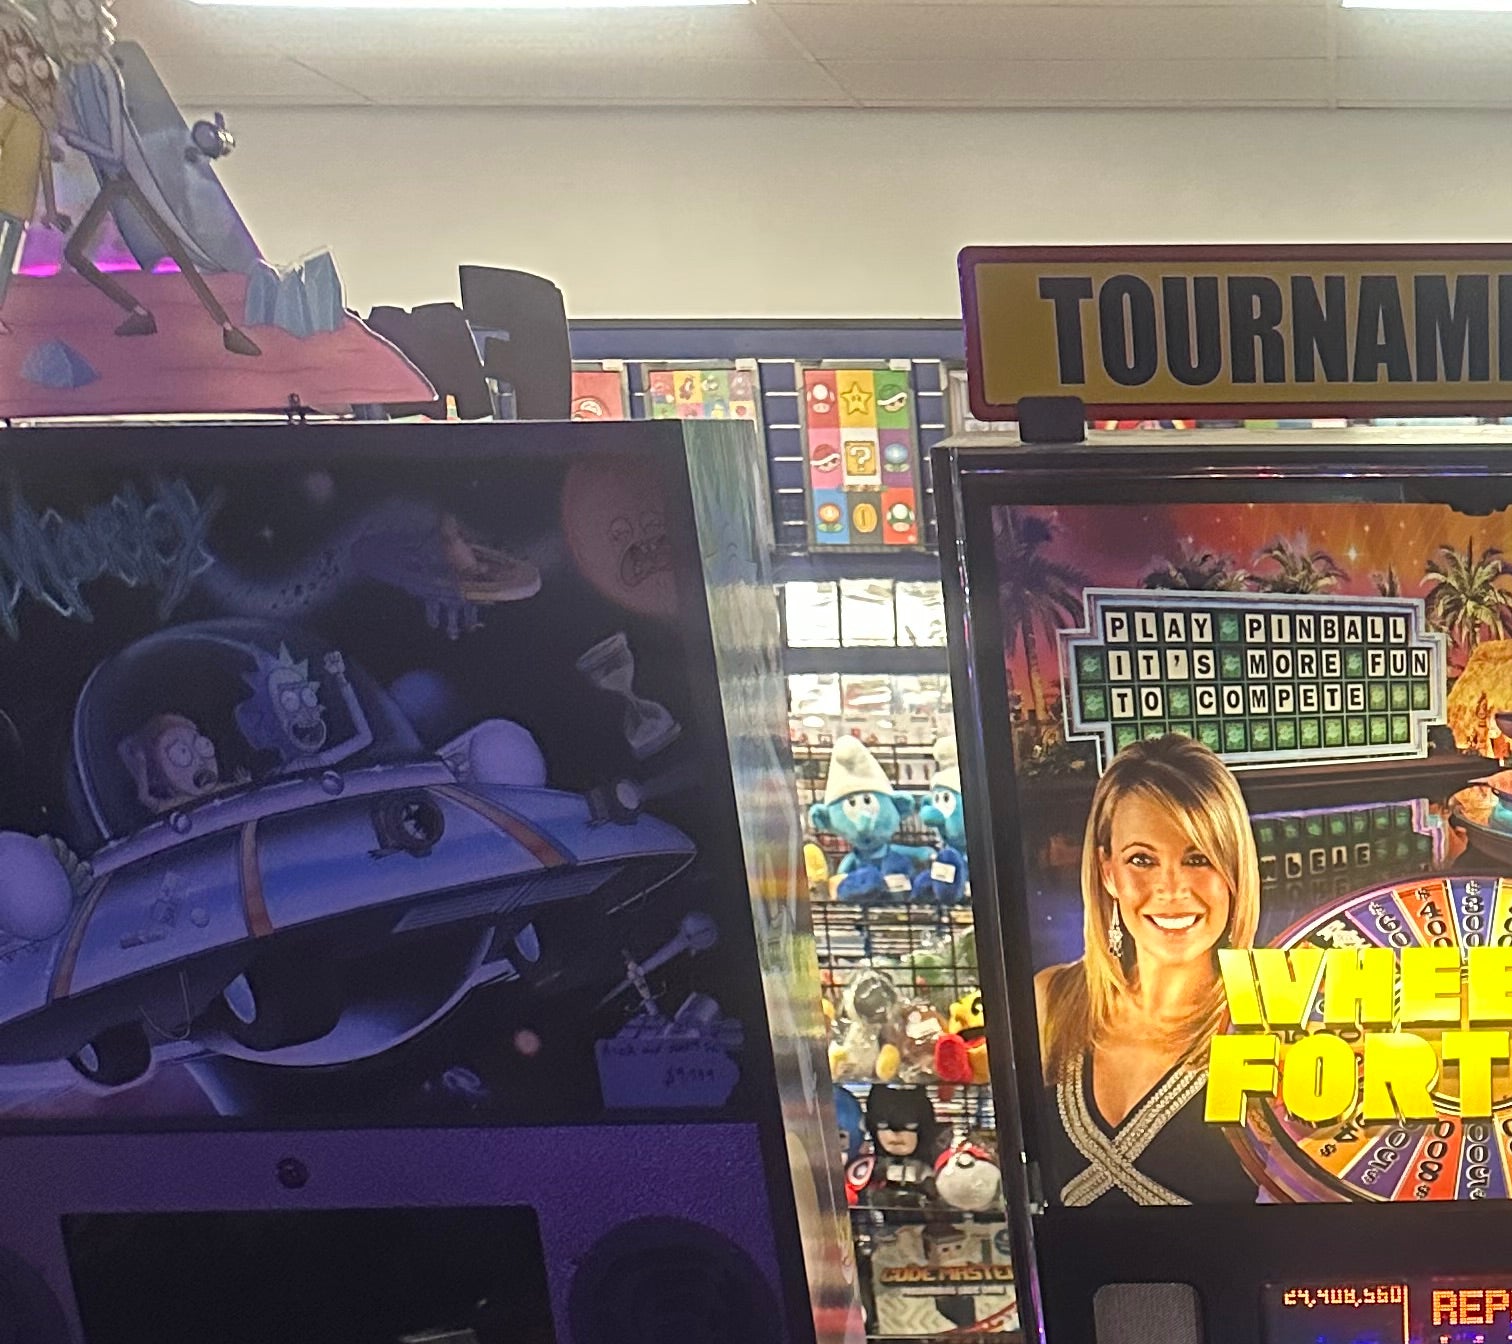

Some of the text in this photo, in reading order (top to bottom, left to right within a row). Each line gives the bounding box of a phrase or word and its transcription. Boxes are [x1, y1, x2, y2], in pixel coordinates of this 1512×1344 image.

[1111, 616, 1404, 640] PLAY PINBALL
[1115, 652, 1428, 677] IT'S MORE FUN
[1116, 686, 1363, 714] TO COMPETE
